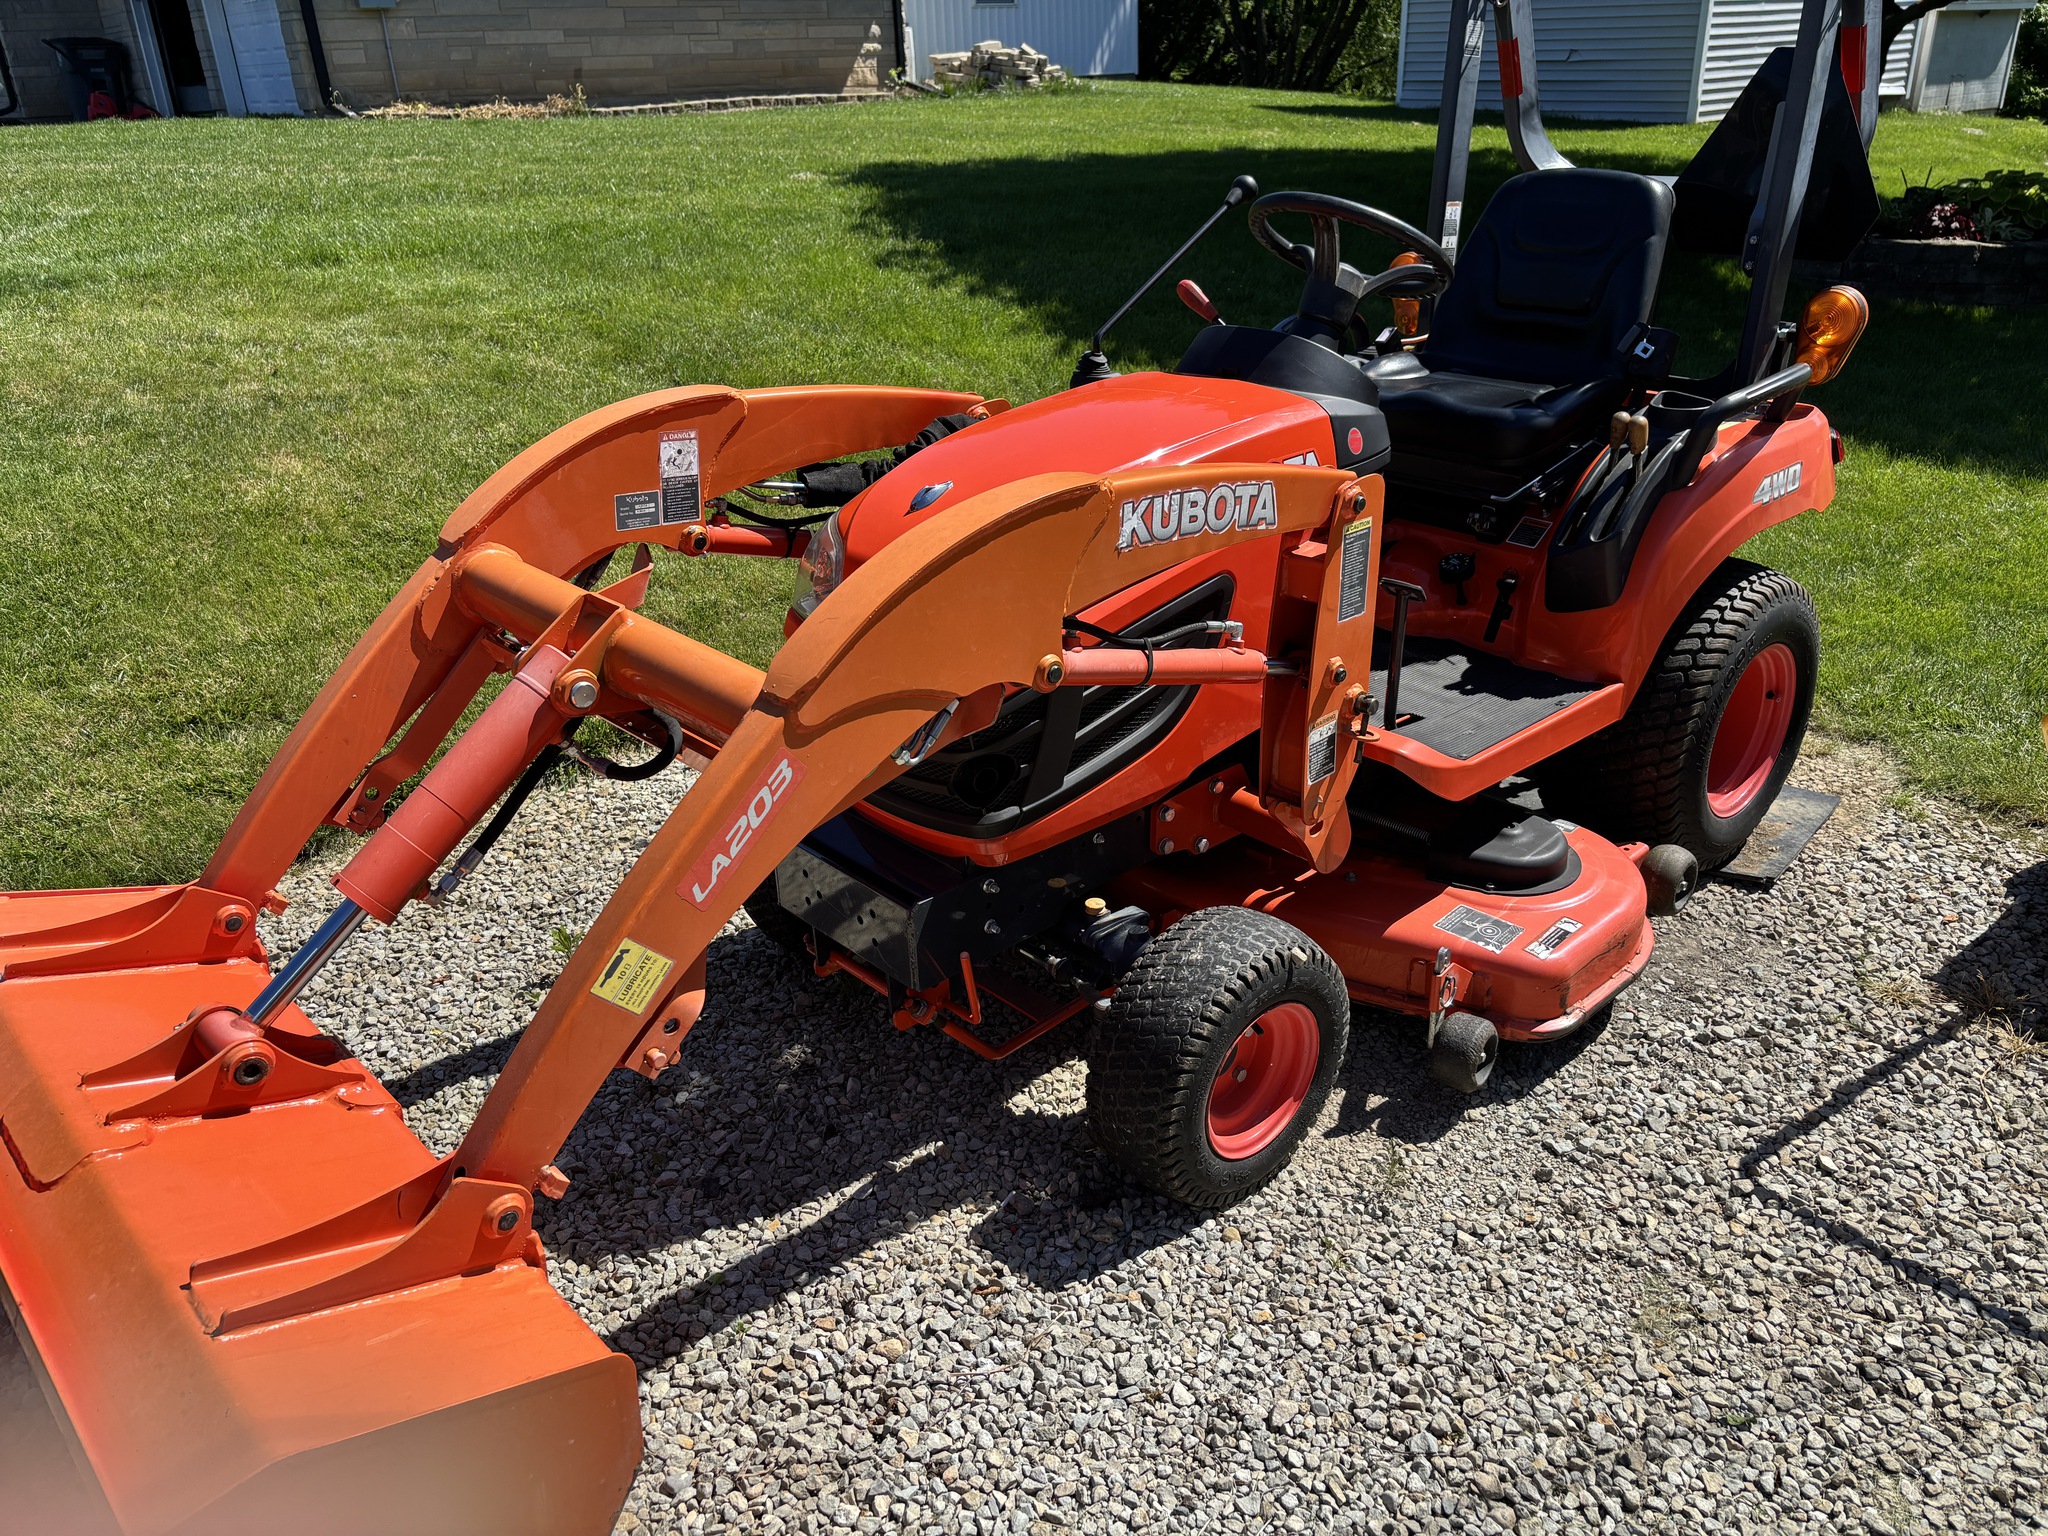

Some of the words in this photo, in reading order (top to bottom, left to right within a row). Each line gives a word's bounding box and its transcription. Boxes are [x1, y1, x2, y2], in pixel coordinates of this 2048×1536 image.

[669, 431, 696, 440] DANGE
[1752, 461, 1802, 506] 4WD
[1118, 481, 1276, 550] KUBOTA
[1350, 520, 1370, 531] CAUTION
[692, 759, 793, 903] LA203
[617, 970, 627, 980] 10
[618, 954, 653, 1002] LUBRICATE
